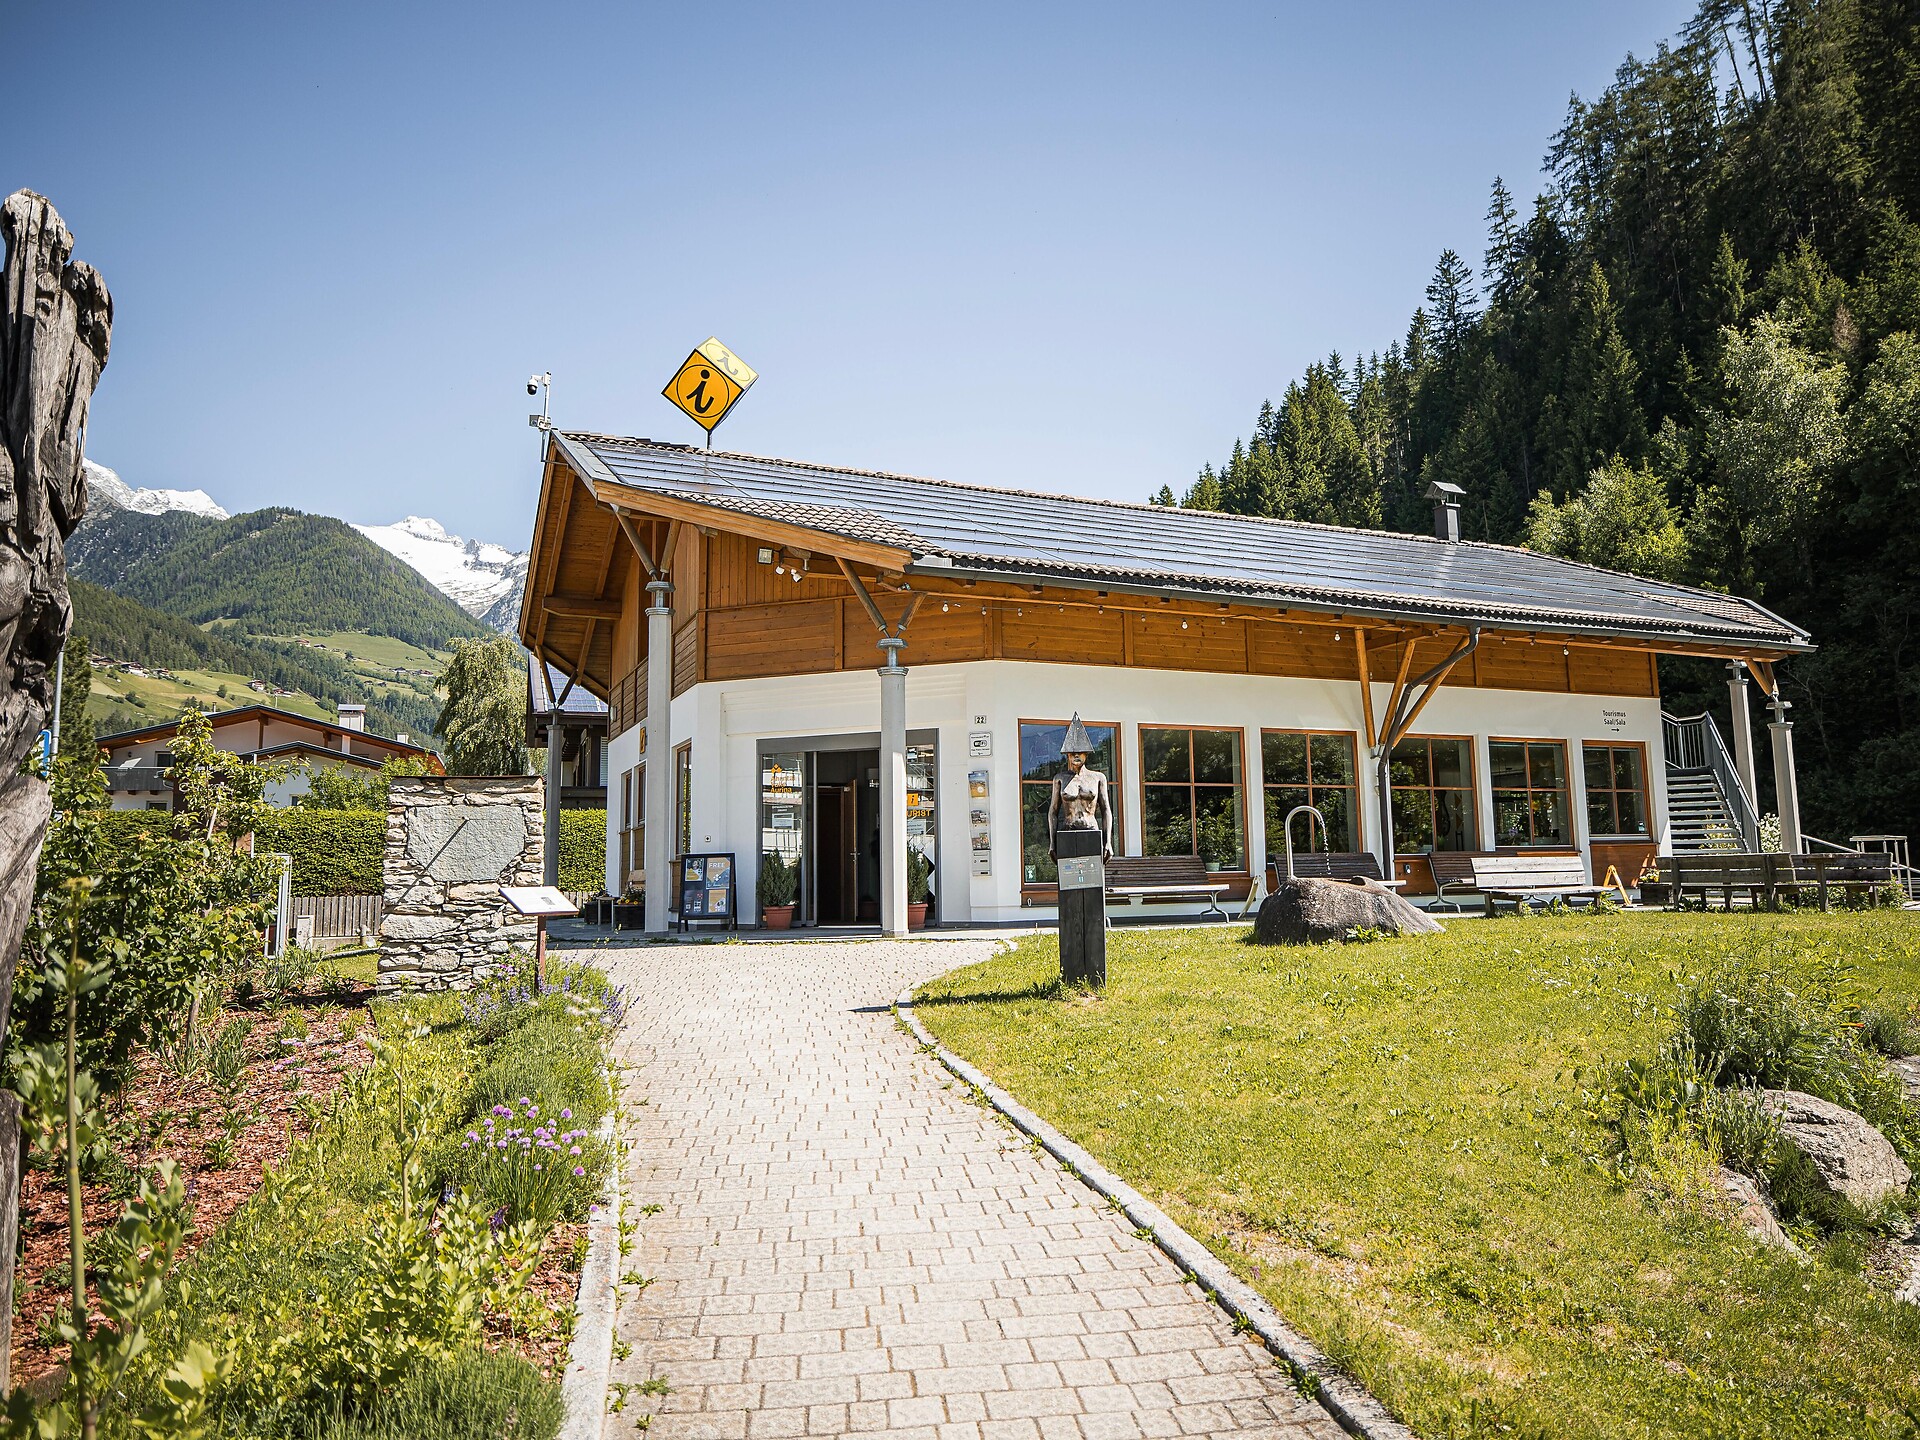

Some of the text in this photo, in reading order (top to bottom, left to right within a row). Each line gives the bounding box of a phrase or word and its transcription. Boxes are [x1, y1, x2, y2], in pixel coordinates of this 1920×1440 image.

[686, 369, 715, 414] i
[1602, 710, 1626, 718] Tourismus
[976, 716, 985, 724] 22
